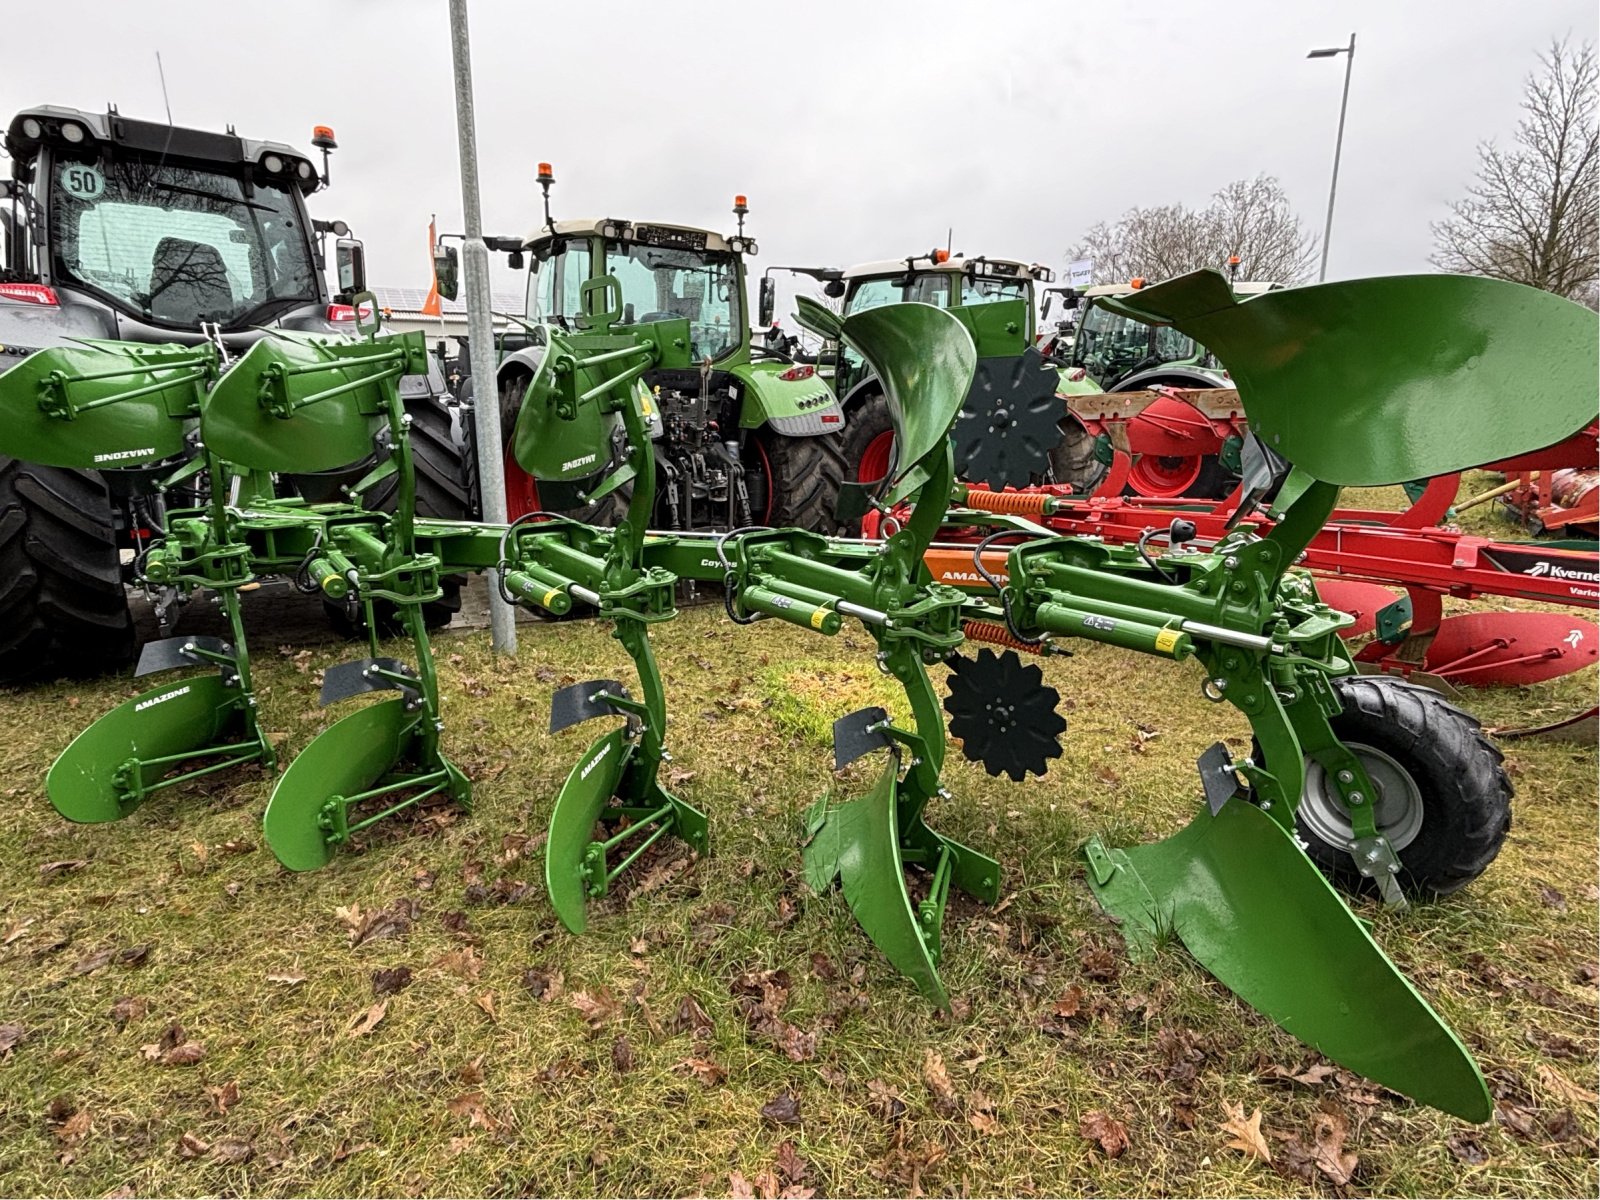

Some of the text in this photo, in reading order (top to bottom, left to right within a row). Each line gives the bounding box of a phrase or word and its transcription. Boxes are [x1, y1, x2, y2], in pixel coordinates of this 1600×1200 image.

[70, 170, 96, 193] 50
[93, 447, 156, 463] AMAZONE
[561, 453, 596, 472] AMAZONE
[1569, 586, 1599, 598] Vario
[134, 685, 191, 712] AMAZONE
[580, 742, 611, 781] AMAZONE
